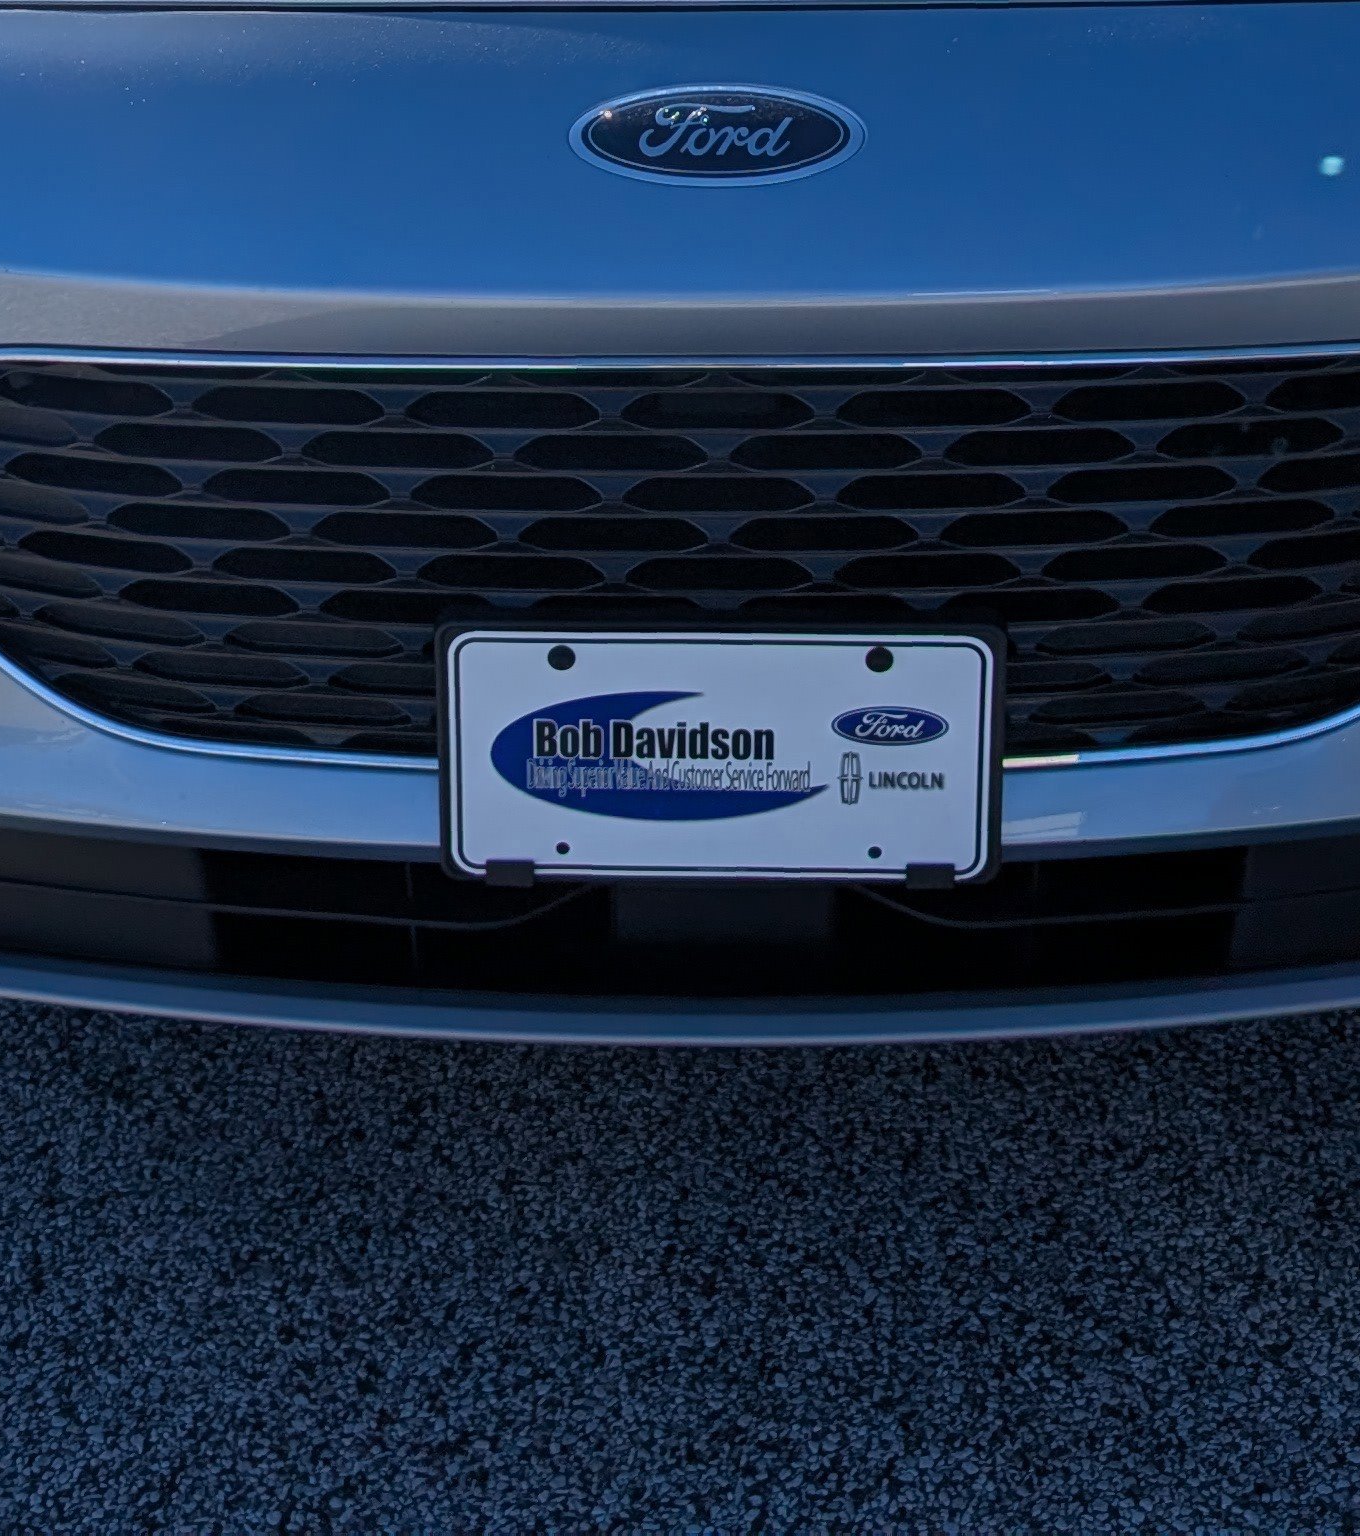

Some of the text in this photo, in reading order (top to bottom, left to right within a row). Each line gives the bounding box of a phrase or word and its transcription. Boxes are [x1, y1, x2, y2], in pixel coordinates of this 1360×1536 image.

[640, 103, 793, 157] Ford
[533, 719, 775, 761] Bob Davidson
[855, 712, 925, 738] Ford
[671, 760, 724, 790] Customer
[725, 761, 765, 791] Service
[766, 761, 811, 792] Forward
[868, 771, 944, 790] LINCOLN
